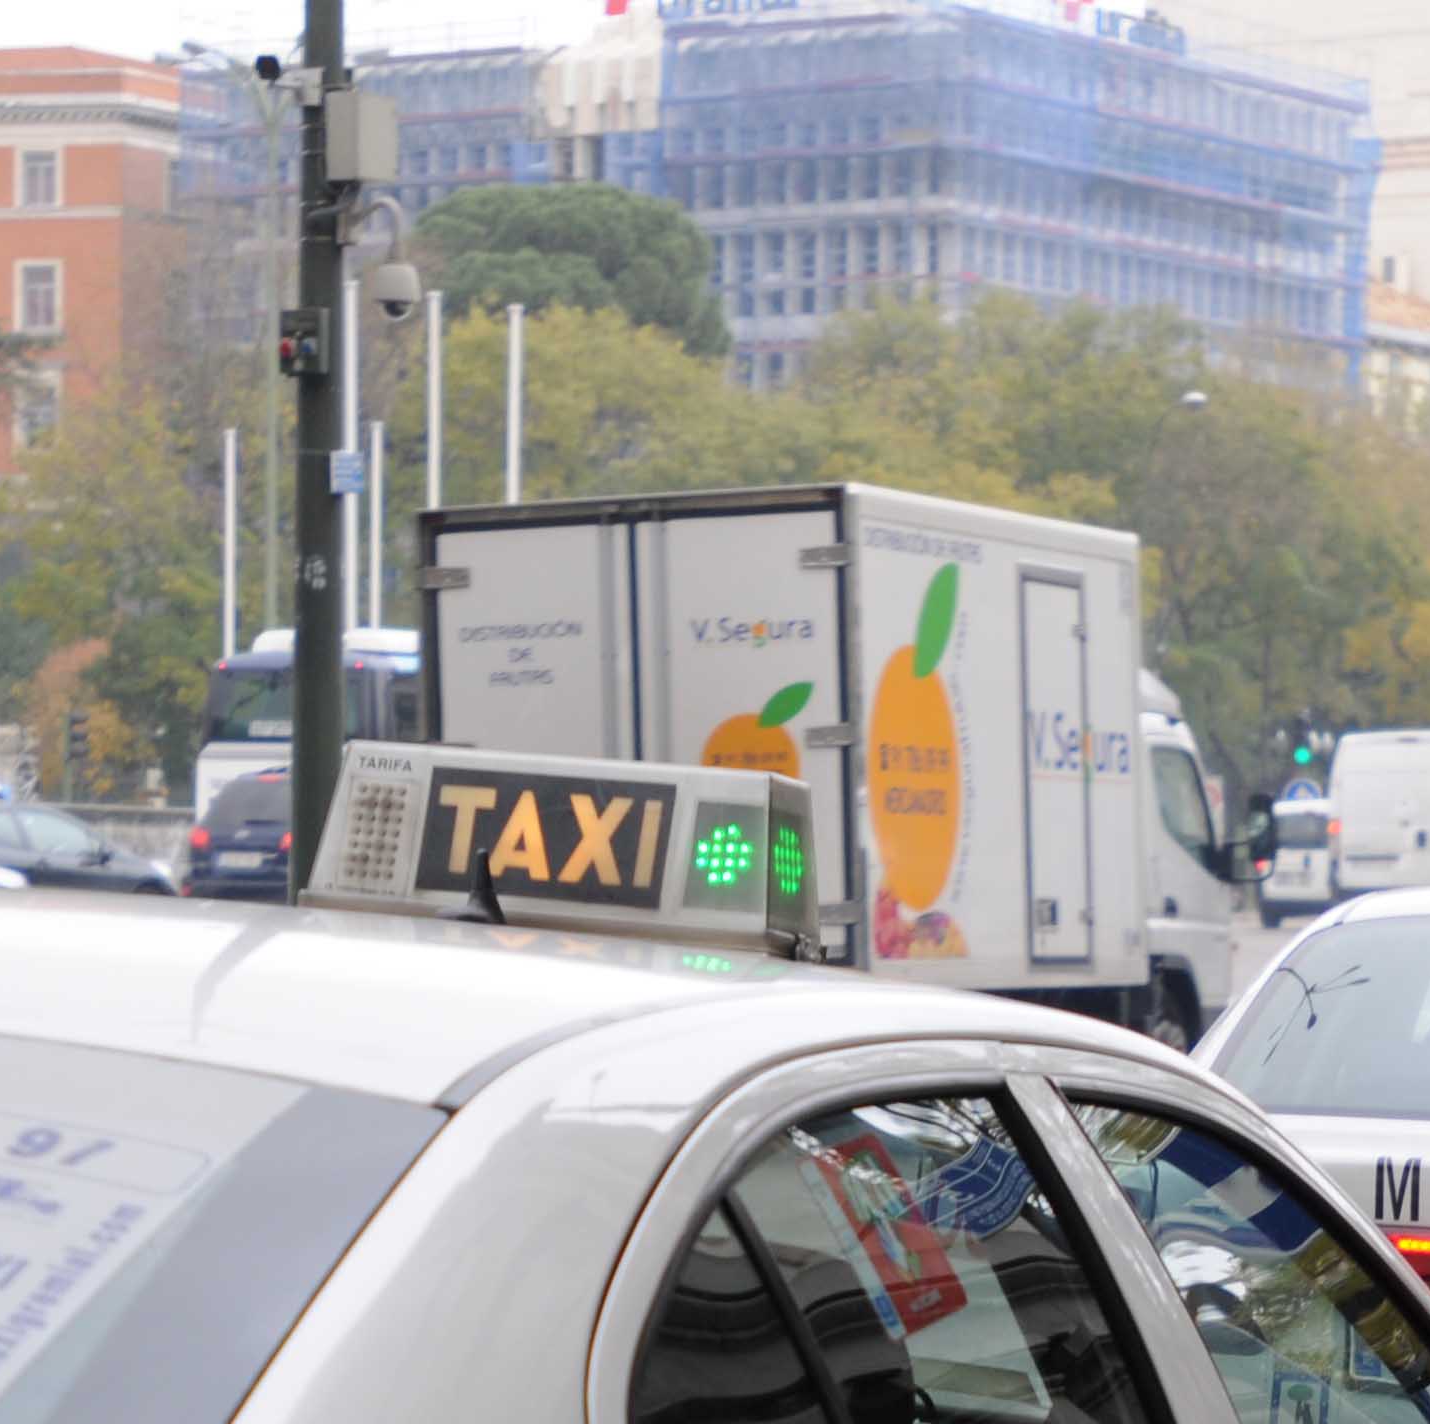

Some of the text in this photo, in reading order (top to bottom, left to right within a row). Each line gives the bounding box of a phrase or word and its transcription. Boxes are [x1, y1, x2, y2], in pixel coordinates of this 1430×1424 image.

[690, 616, 814, 648] V.Segura
[358, 756, 413, 773] TARIFA
[439, 784, 664, 889] TAXI
[1374, 1156, 1422, 1222] M
